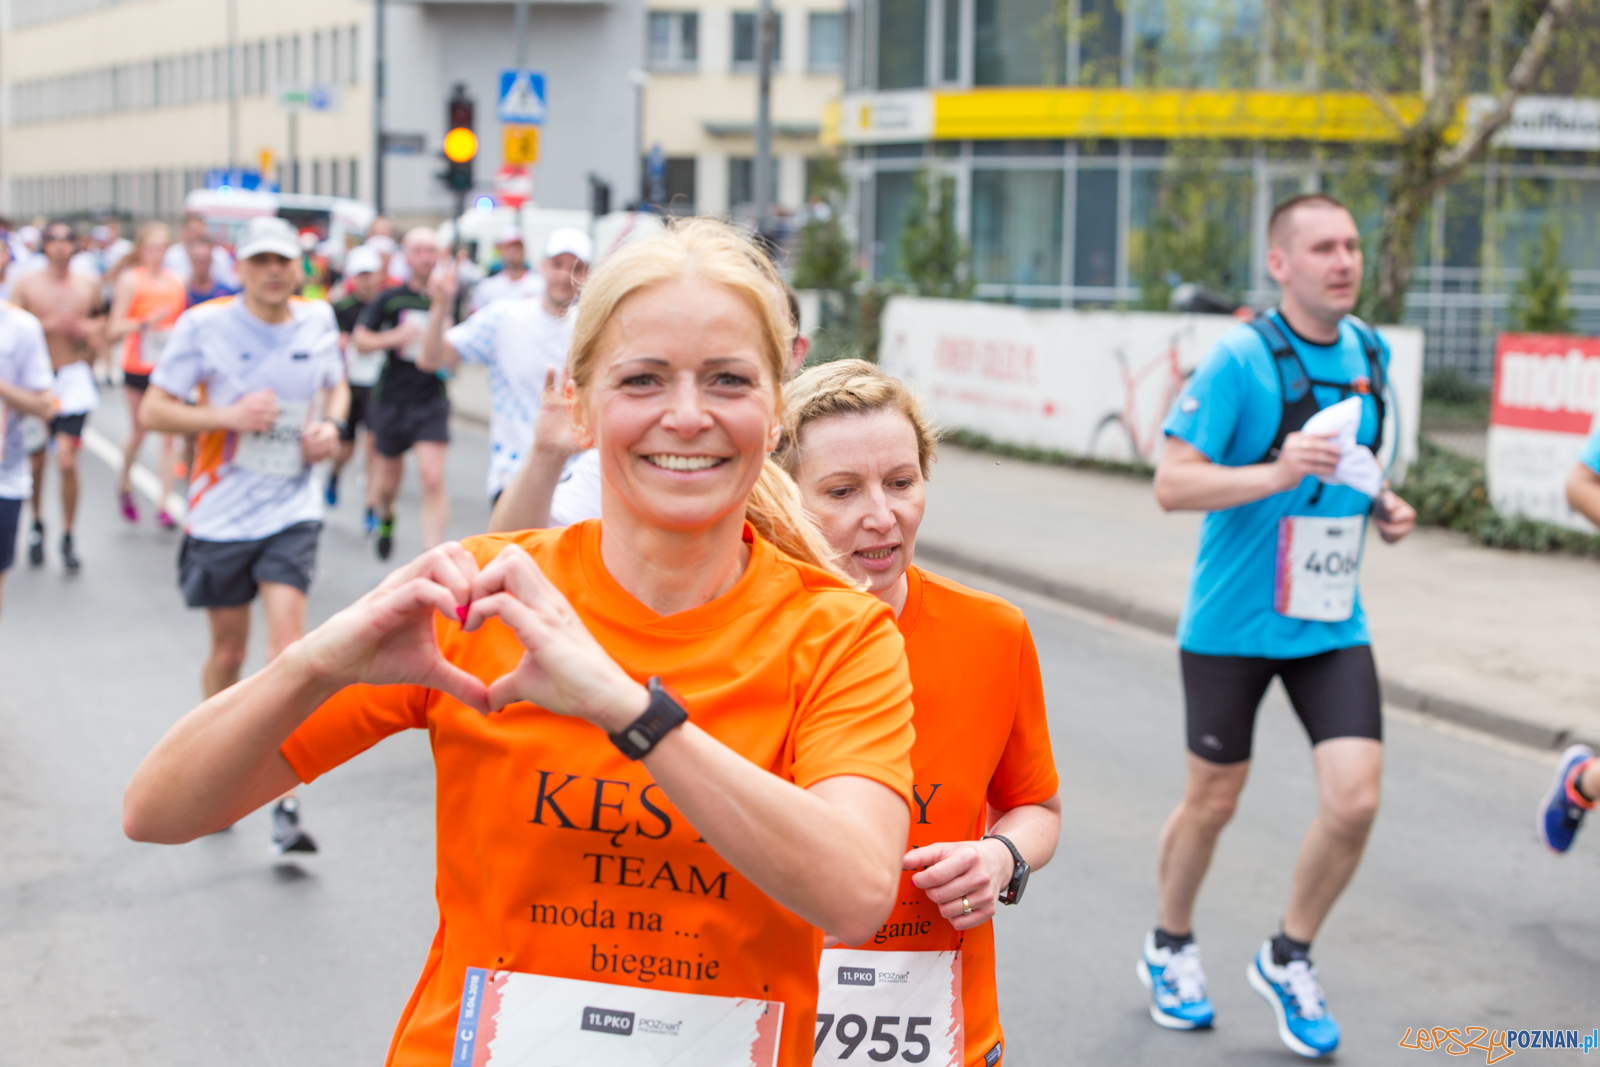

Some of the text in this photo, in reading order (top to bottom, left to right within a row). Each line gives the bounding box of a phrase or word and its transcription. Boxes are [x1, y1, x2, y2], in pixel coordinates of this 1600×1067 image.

[527, 769, 708, 848] KĘS
[583, 852, 731, 901] TEAM
[530, 900, 615, 930] moda
[627, 911, 663, 932] na
[873, 915, 931, 945] ganie
[590, 943, 720, 983] bieganie
[853, 972, 873, 982] PKO
[603, 1014, 631, 1030] PKO
[814, 1013, 932, 1063] 7955
